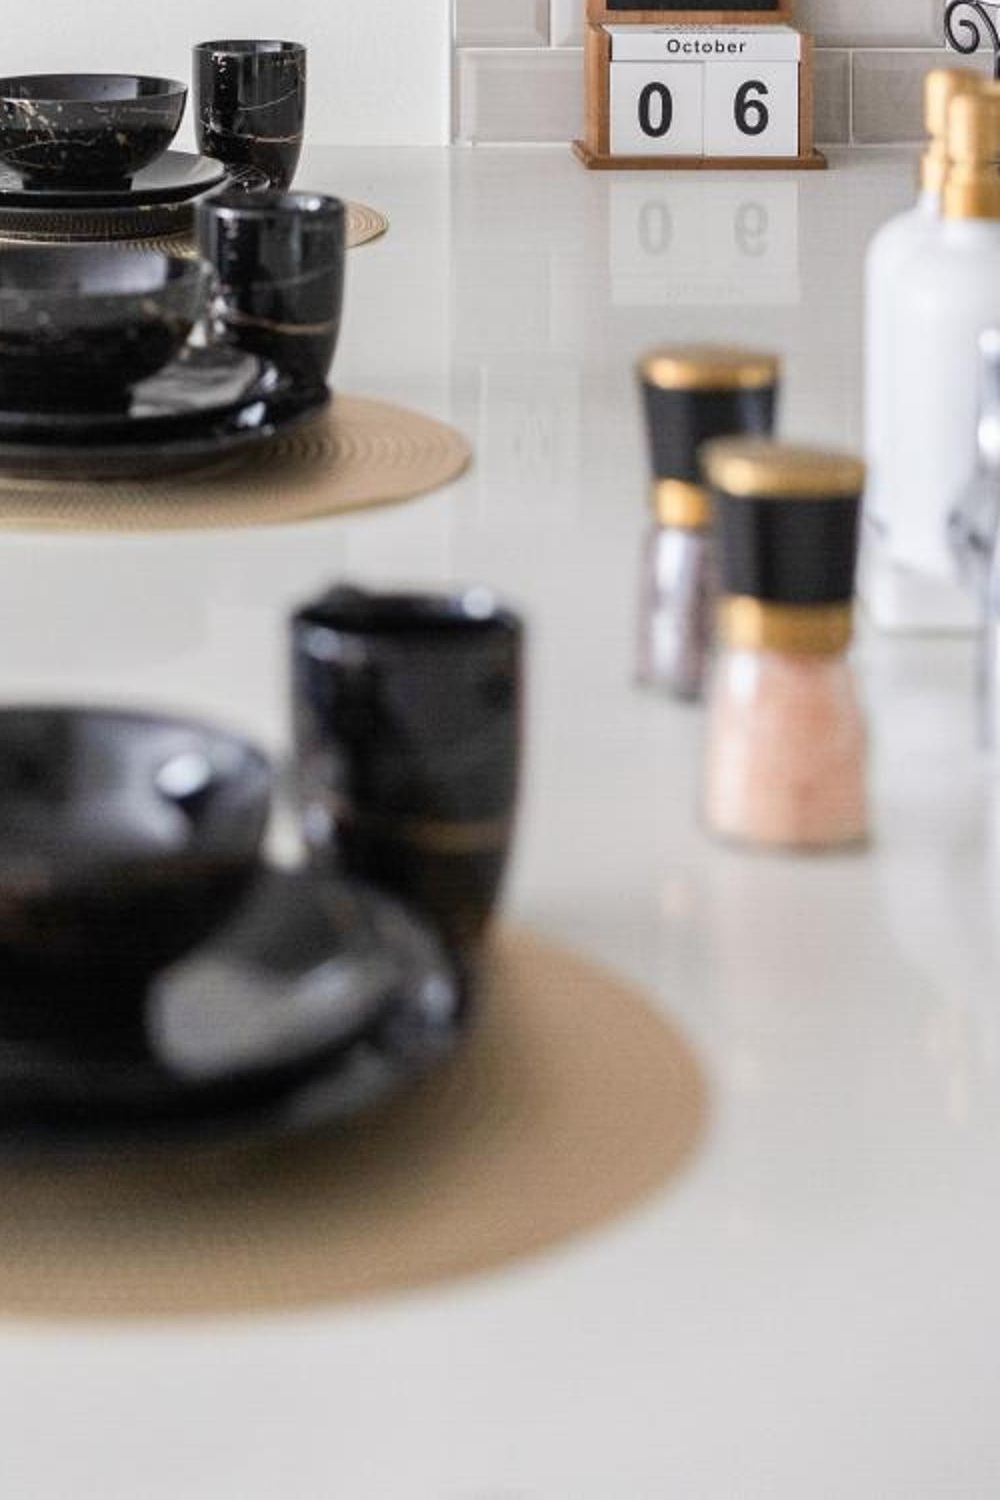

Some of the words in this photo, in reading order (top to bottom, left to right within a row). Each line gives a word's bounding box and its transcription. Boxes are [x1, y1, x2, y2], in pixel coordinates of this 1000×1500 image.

[666, 38, 747, 54] October
[637, 81, 673, 138] 0
[733, 80, 769, 136] 6
